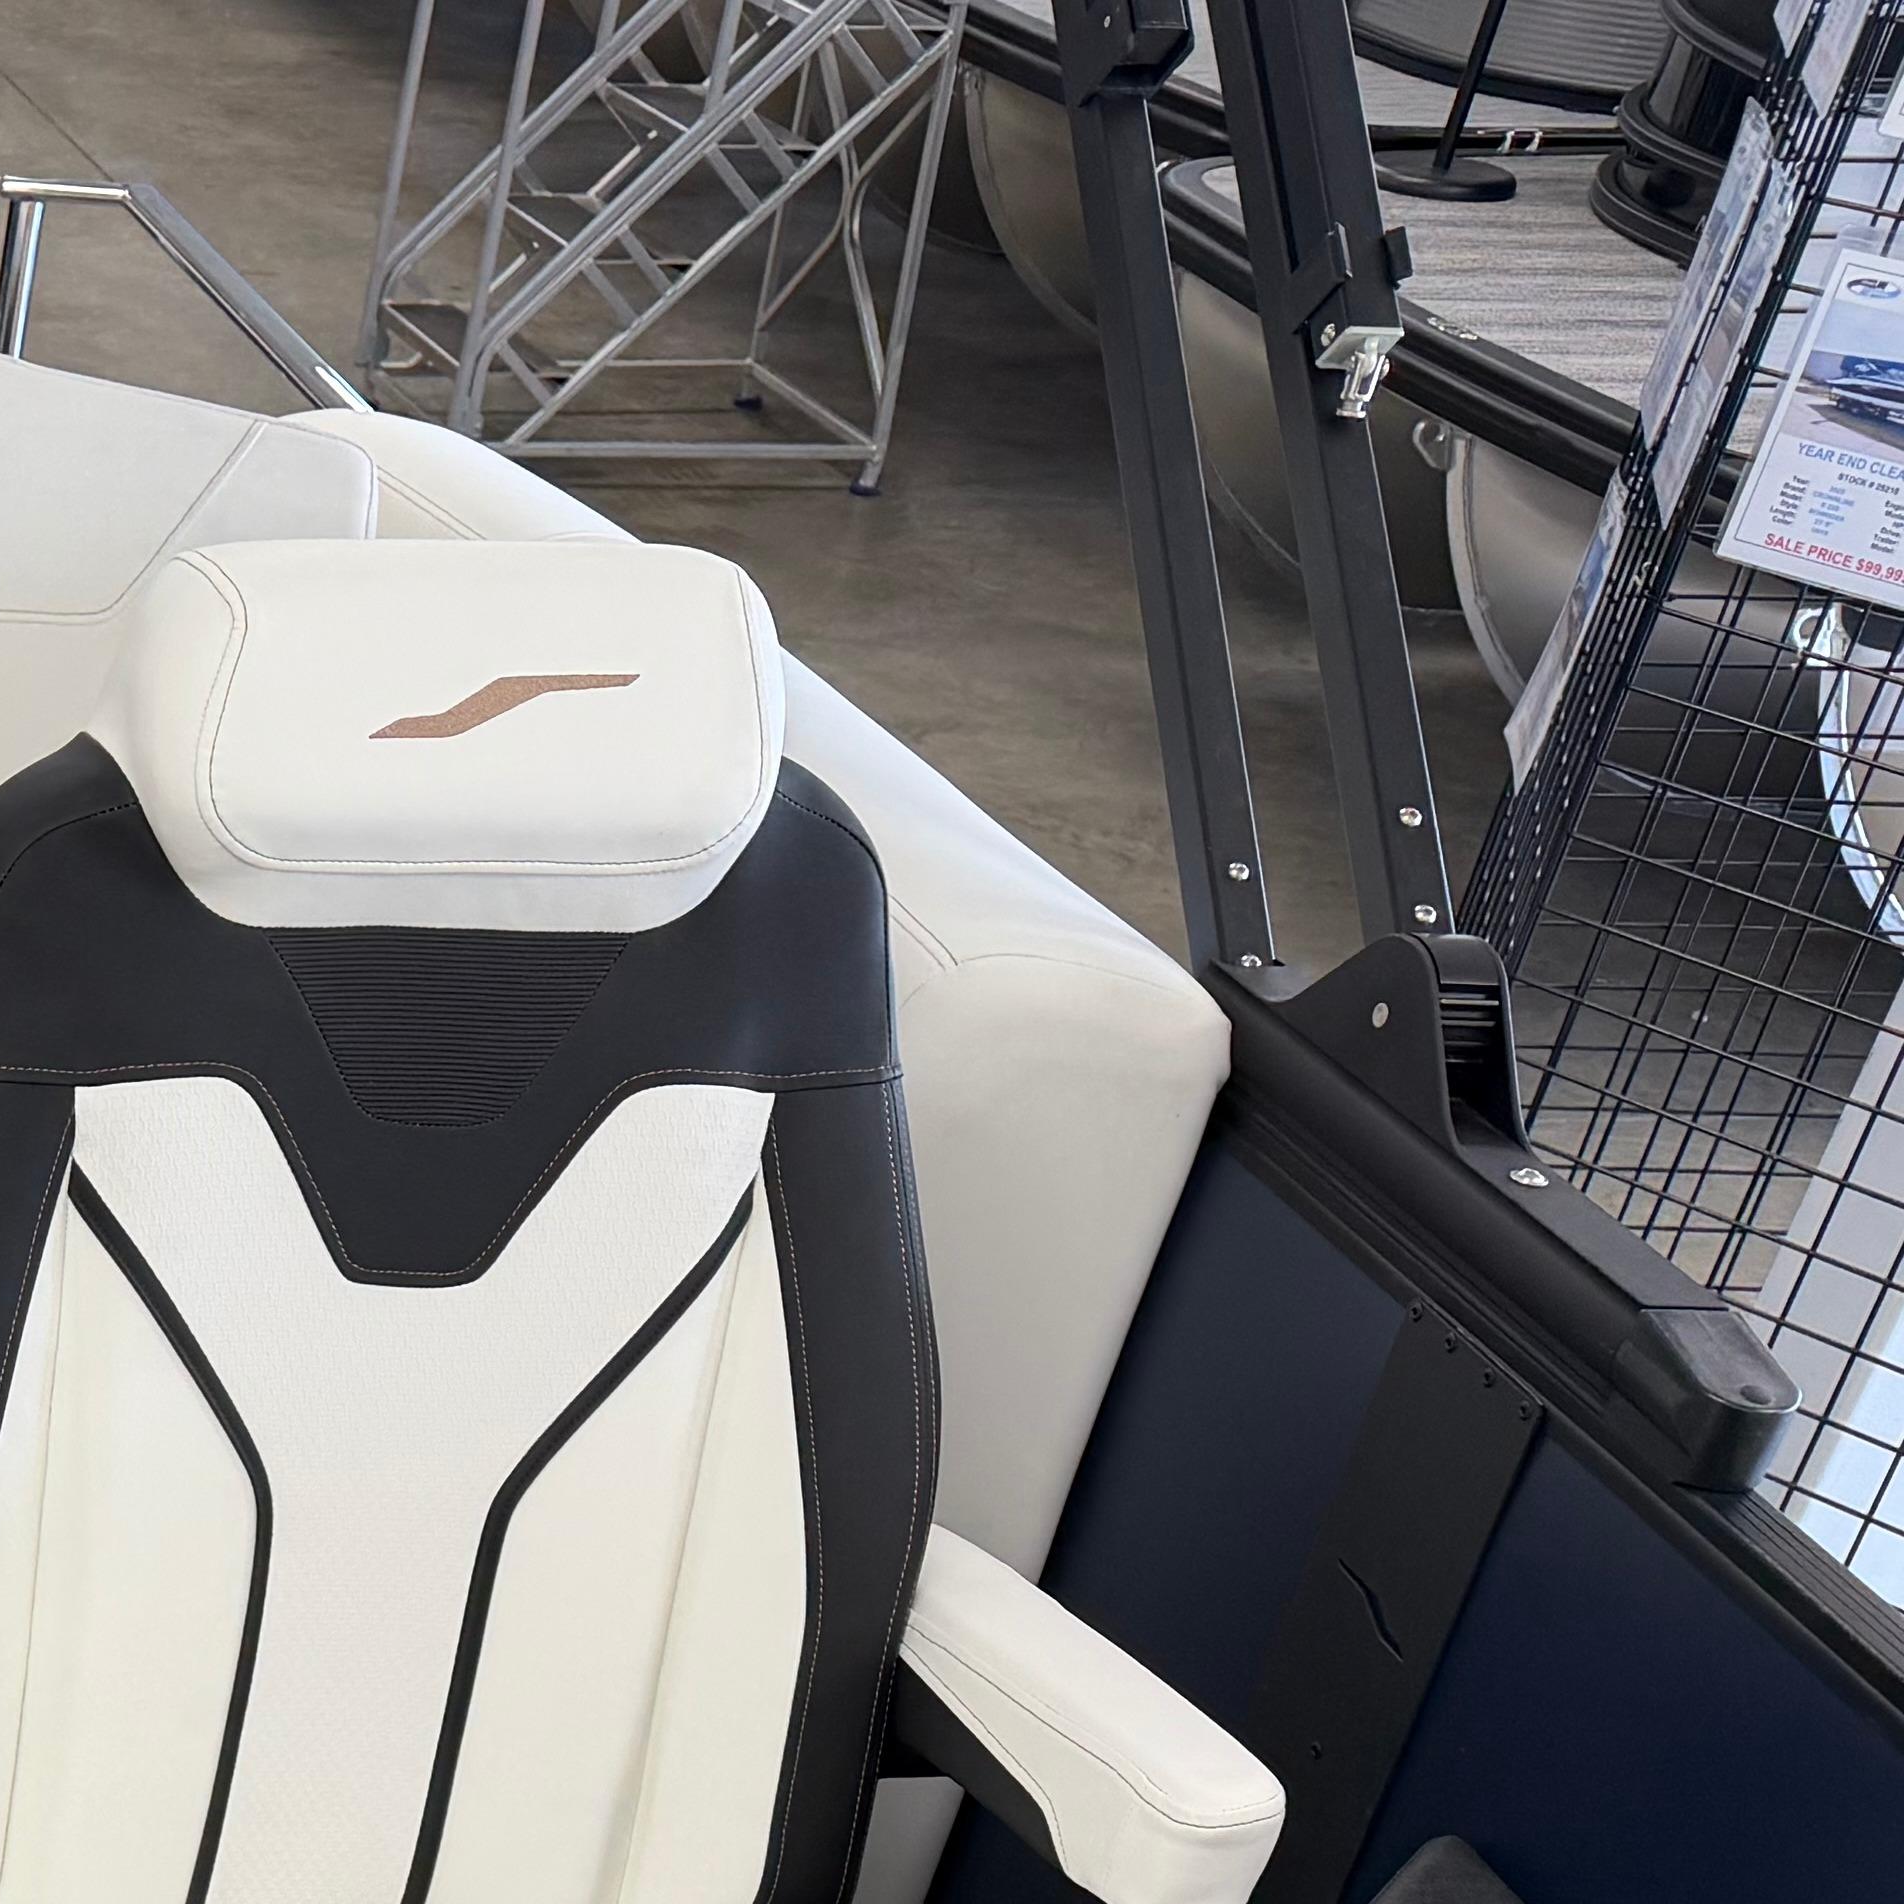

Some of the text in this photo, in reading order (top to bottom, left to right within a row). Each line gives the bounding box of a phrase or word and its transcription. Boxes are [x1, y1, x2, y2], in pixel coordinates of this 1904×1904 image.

[1798, 443, 1834, 462] YEAR
[1837, 453, 1866, 470] END
[1838, 473, 1866, 486] STOCK
[1765, 533, 1904, 584] SALE PRICE $99,99
